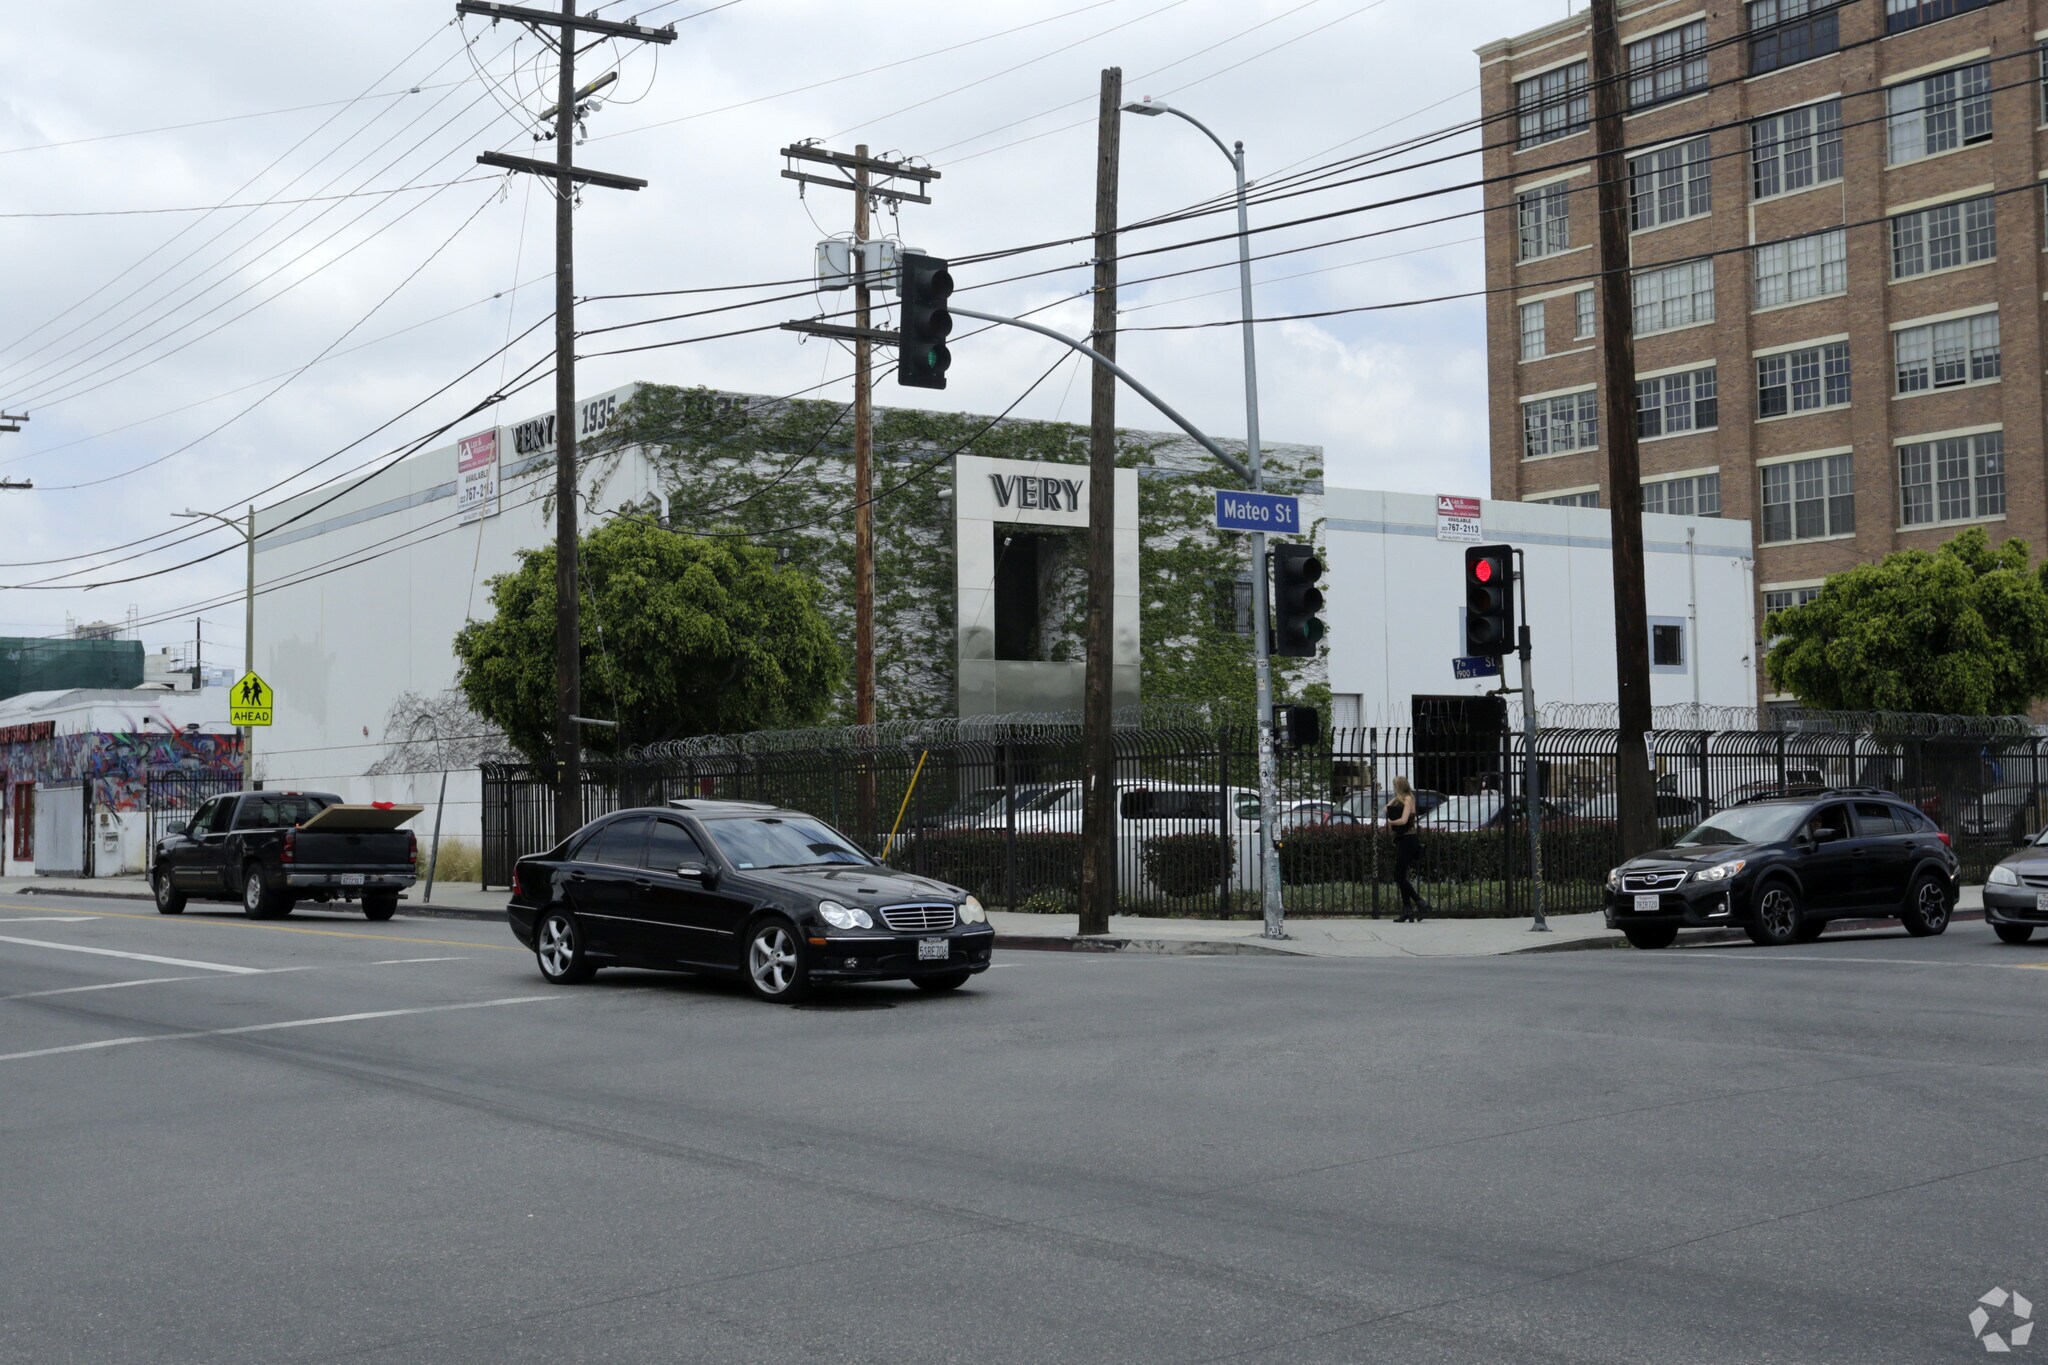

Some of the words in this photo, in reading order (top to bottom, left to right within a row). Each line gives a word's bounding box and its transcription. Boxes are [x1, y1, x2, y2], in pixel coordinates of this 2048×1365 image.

[511, 415, 555, 454] VERY
[582, 394, 616, 434] 1935
[989, 473, 1084, 512] VERY
[1224, 499, 1270, 522] Mateo
[1275, 503, 1292, 524] St
[1448, 523, 1479, 534] 767-2113
[1485, 656, 1496, 668] St
[1456, 669, 1471, 678] 1900
[1473, 668, 1477, 677] E
[233, 711, 270, 721] AHEAD
